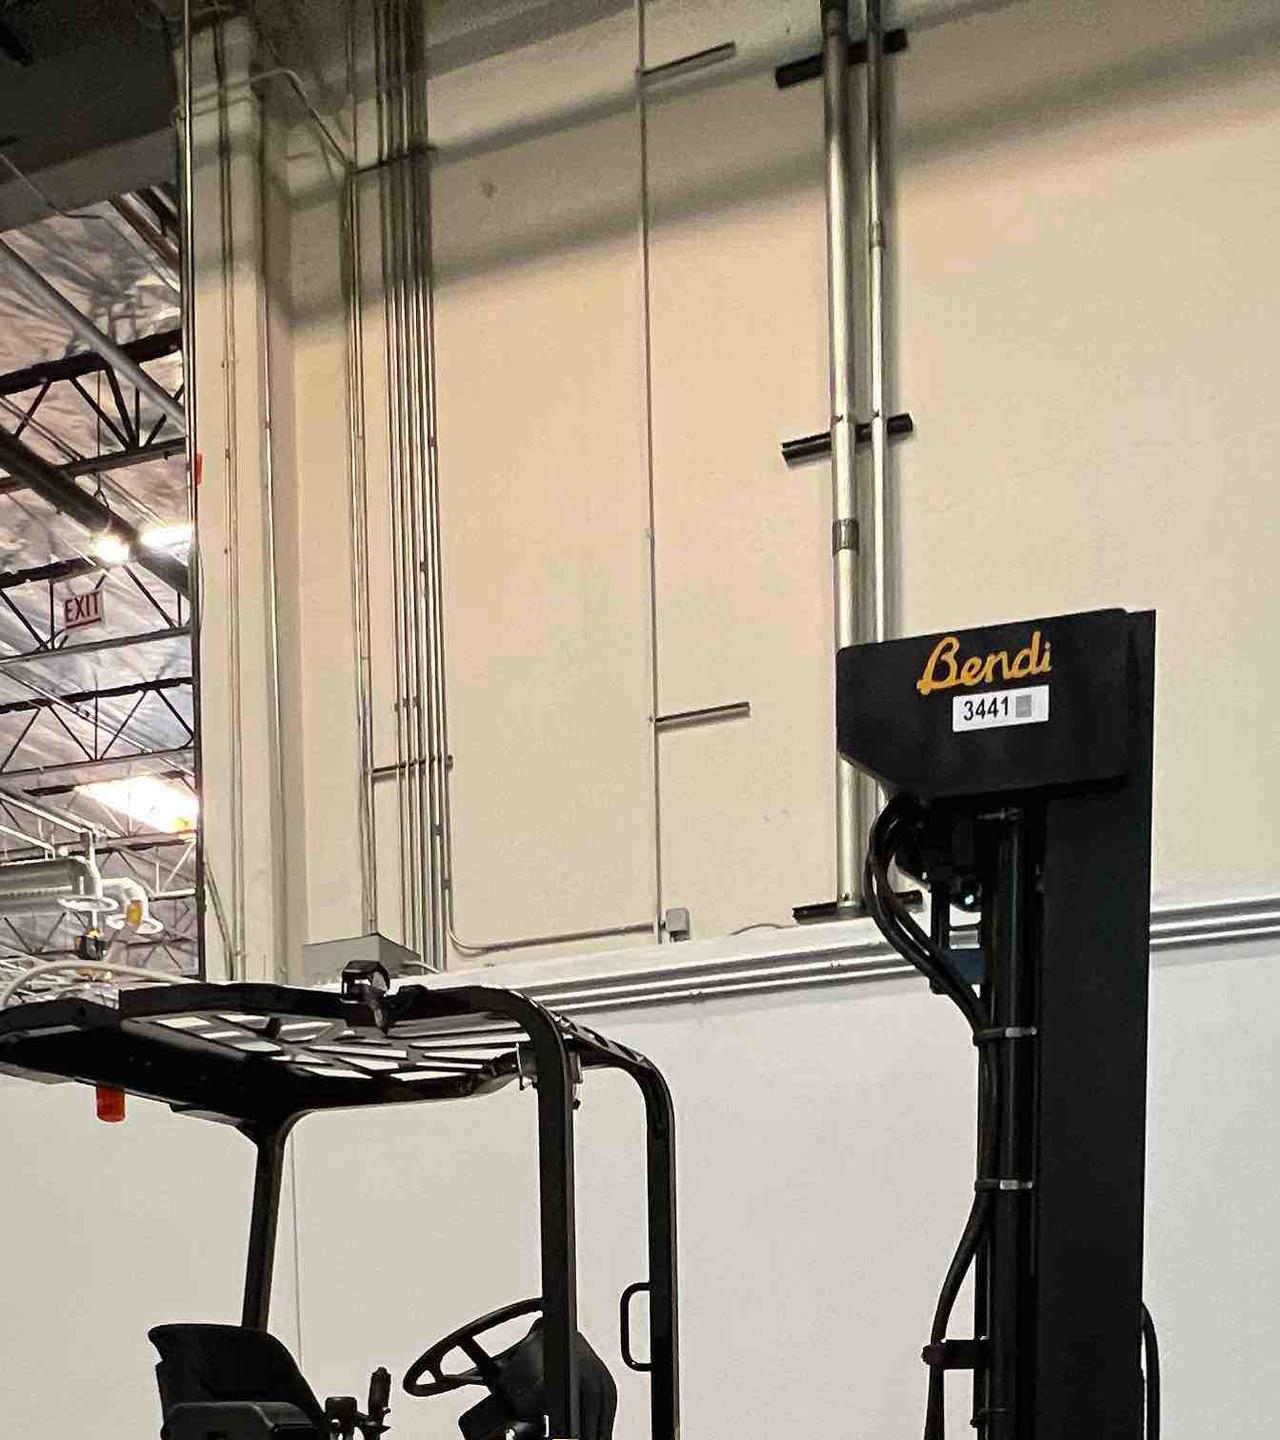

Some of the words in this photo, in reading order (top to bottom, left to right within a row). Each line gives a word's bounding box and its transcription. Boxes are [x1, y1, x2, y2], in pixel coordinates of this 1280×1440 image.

[64, 591, 100, 622] EXIT
[916, 631, 1052, 695] Bendi
[963, 697, 1009, 721] 3441
